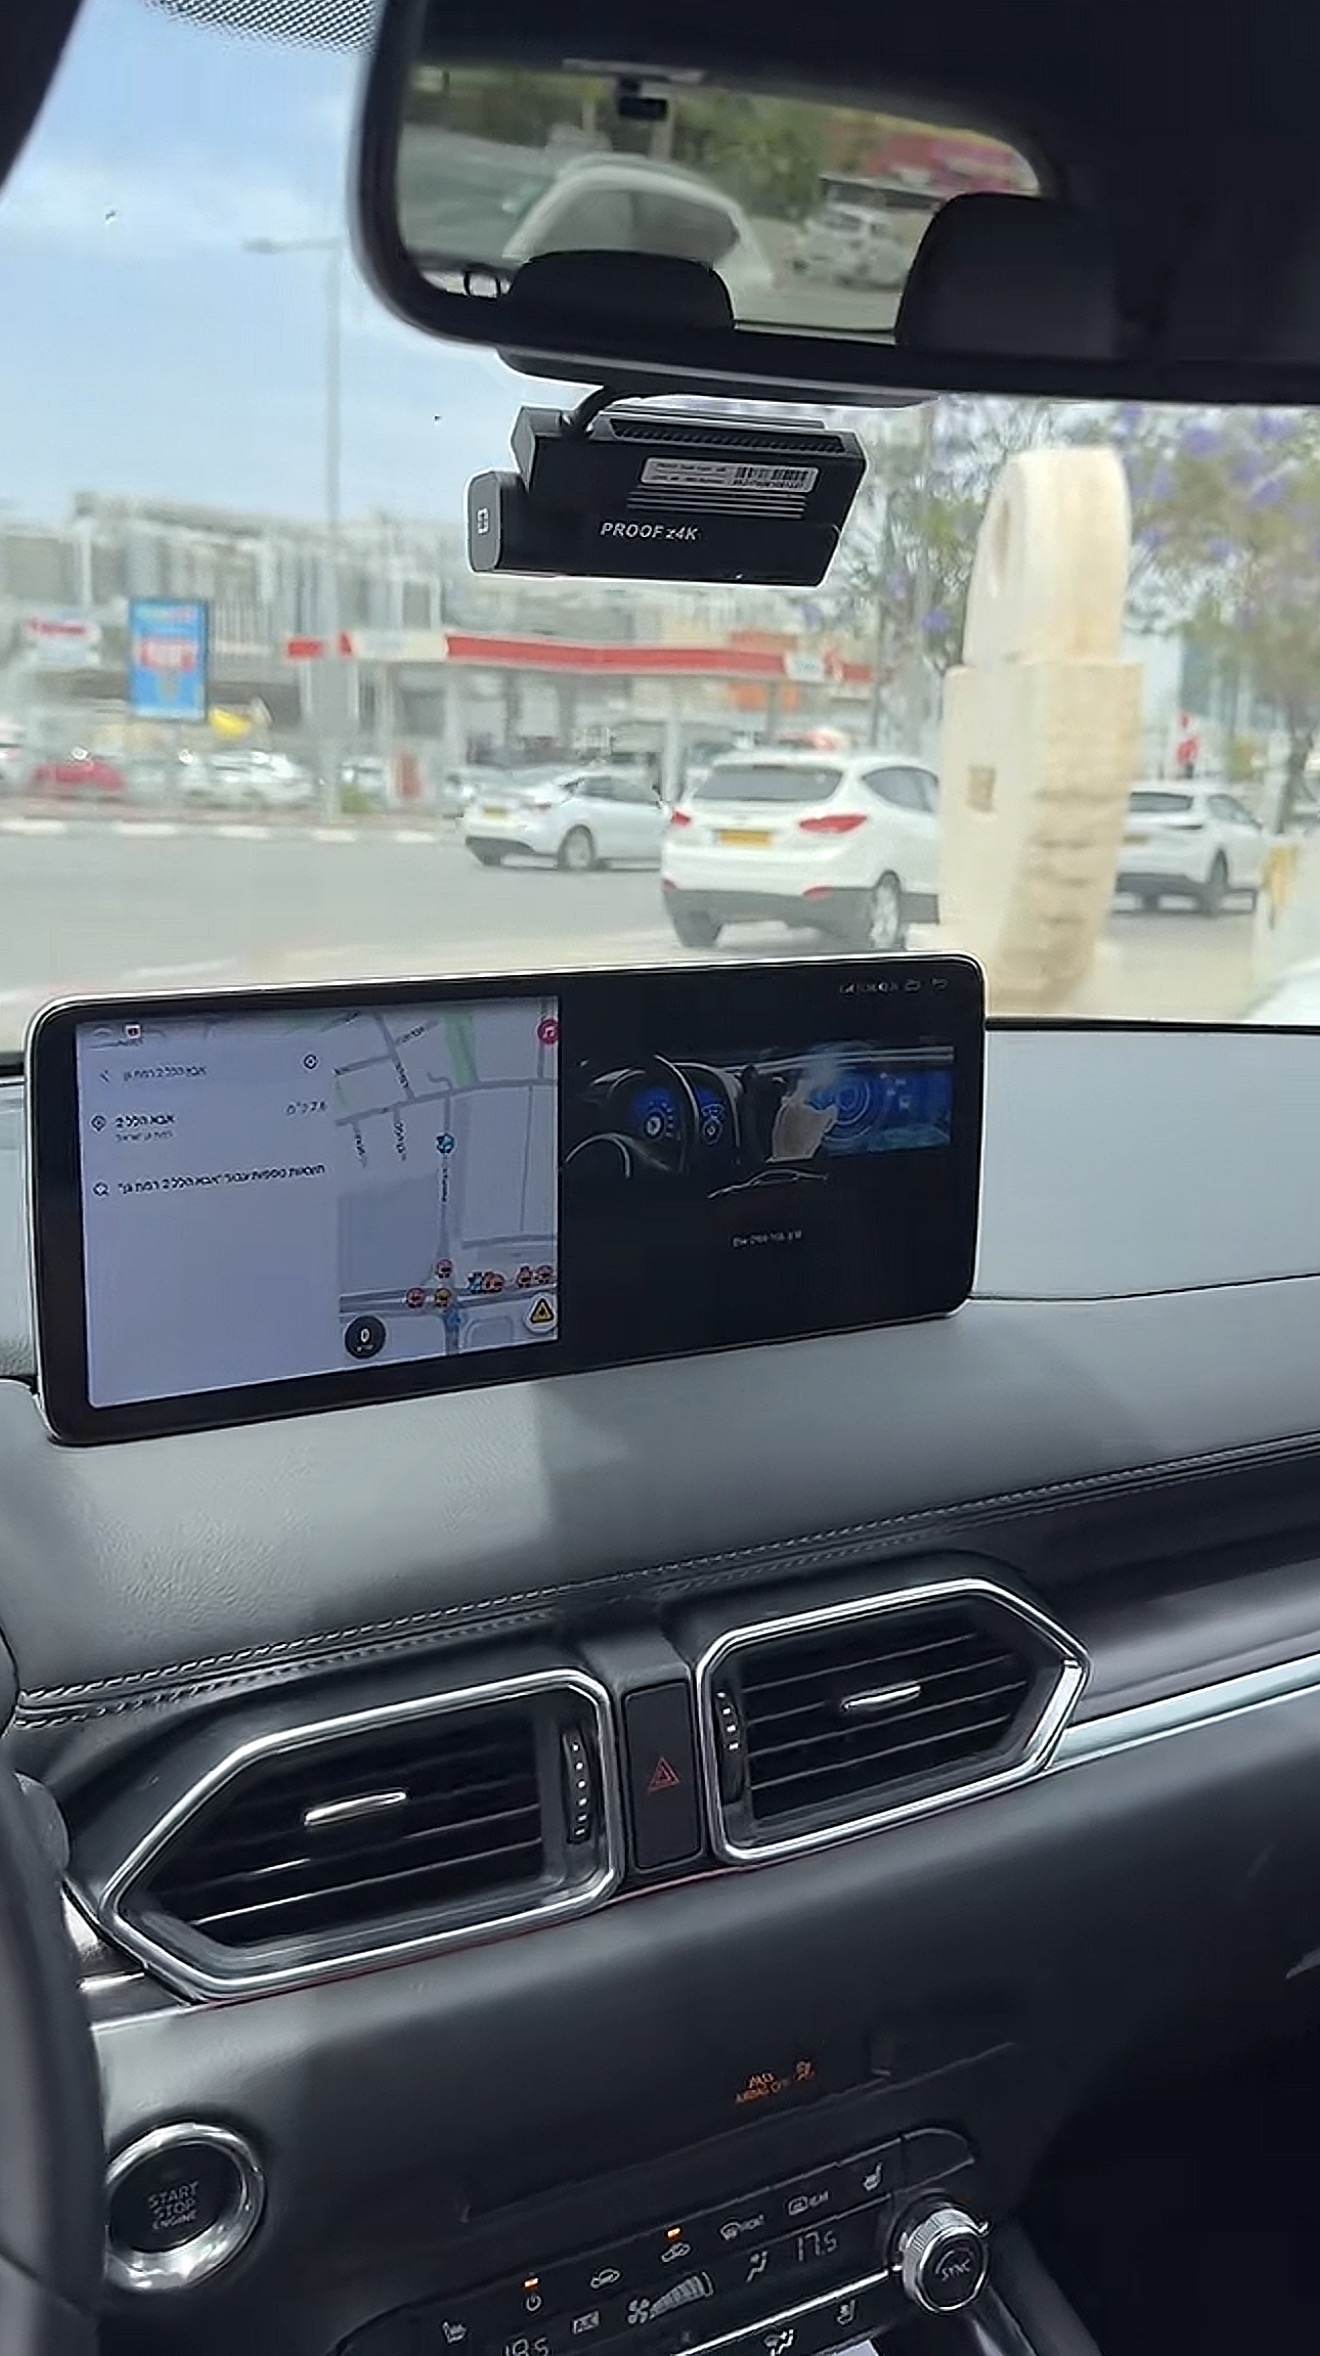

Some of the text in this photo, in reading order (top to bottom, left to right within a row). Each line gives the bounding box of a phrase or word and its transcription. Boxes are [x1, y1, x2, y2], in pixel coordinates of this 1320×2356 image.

[600, 521, 665, 539] PROOF
[148, 2180, 199, 2209] START
[153, 2197, 196, 2220] STOP
[941, 2258, 971, 2281] SYNC
